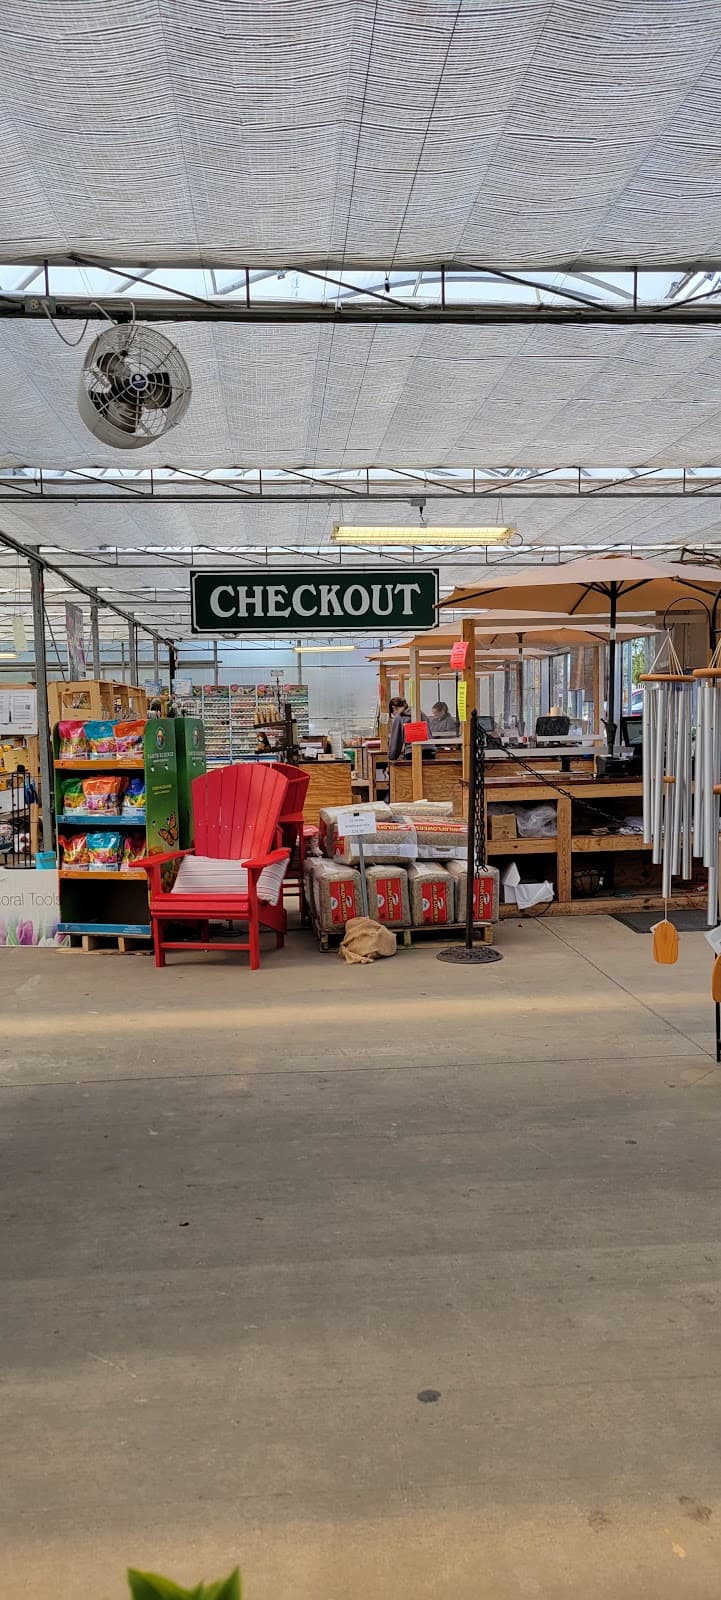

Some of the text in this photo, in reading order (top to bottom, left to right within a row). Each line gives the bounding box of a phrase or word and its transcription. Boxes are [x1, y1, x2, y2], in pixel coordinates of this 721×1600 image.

[209, 583, 421, 618] CHECKOUT
[0, 892, 61, 906] oral Tools
